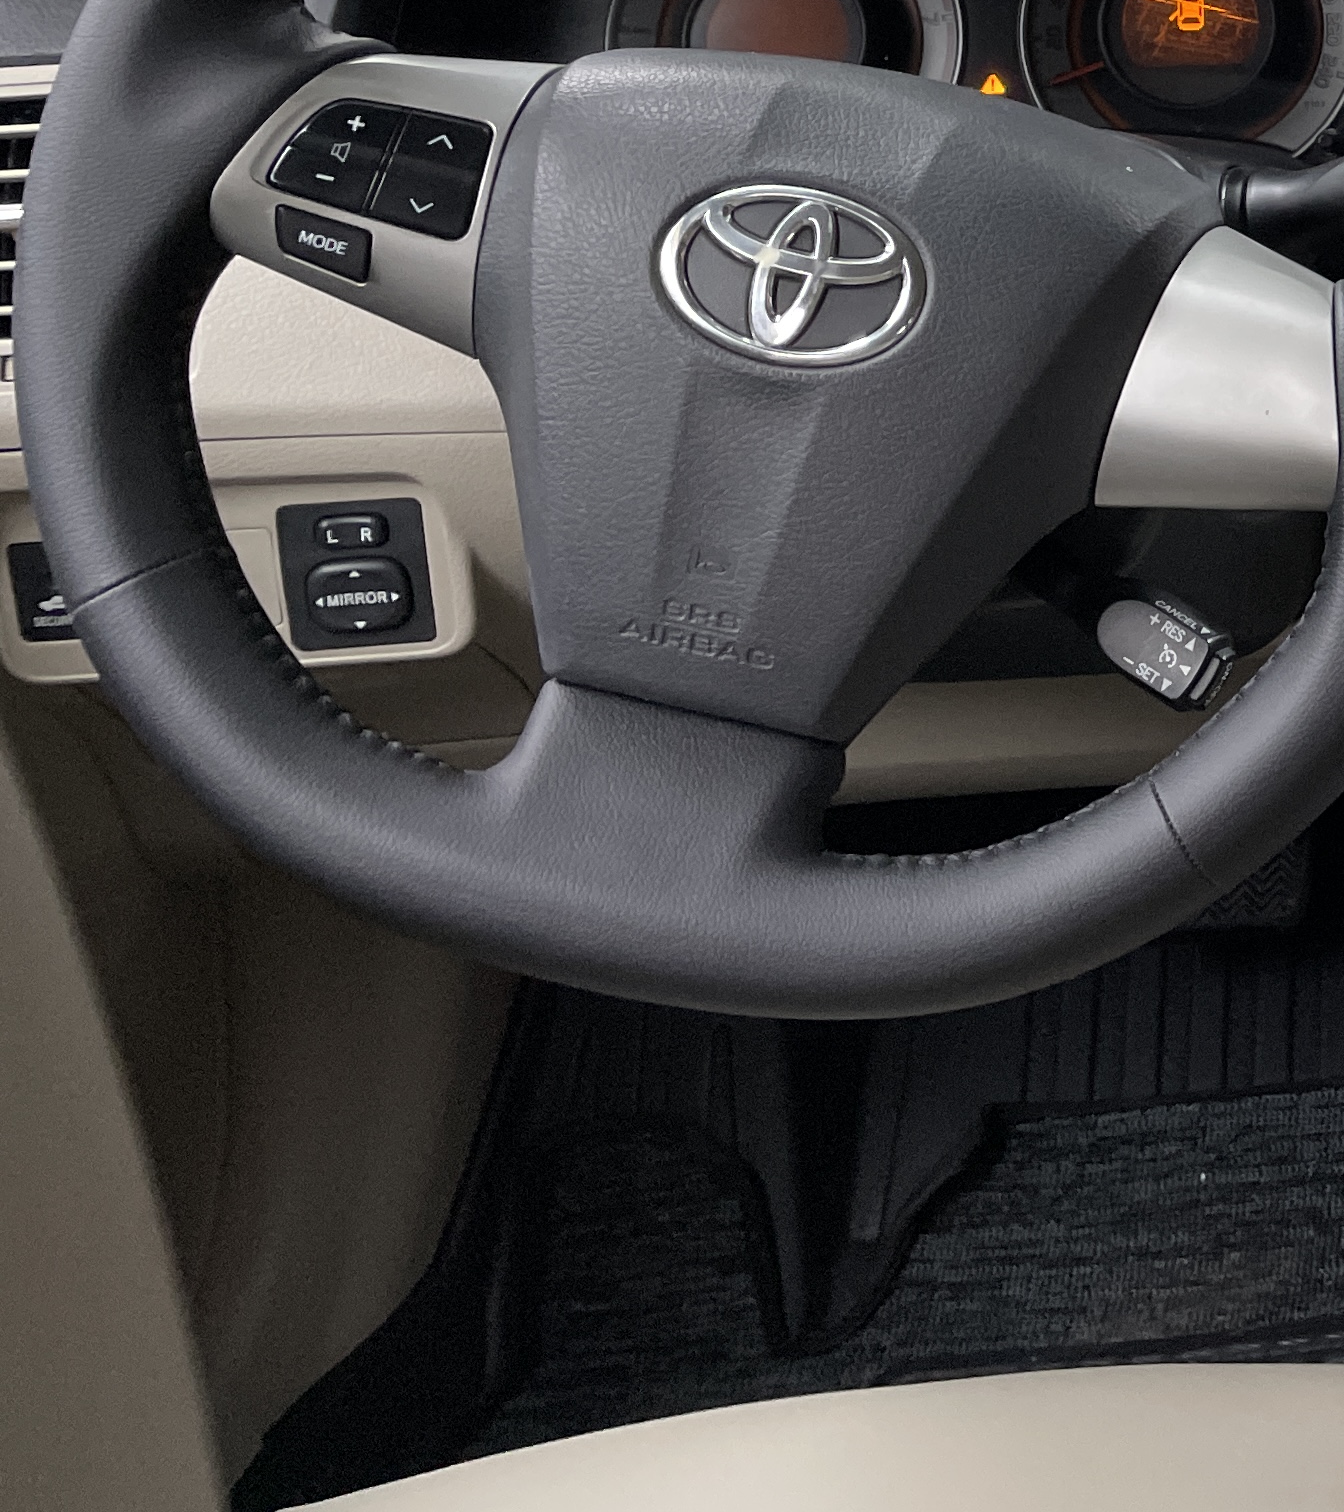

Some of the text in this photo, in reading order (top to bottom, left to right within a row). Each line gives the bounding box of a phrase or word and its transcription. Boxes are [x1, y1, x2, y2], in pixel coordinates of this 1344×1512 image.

[298, 229, 349, 256] MODE
[327, 527, 372, 544] L R
[326, 591, 388, 607] MIRROR
[1155, 600, 1197, 630] CANCEL
[1161, 621, 1186, 642] RES
[1136, 663, 1160, 684] SET
